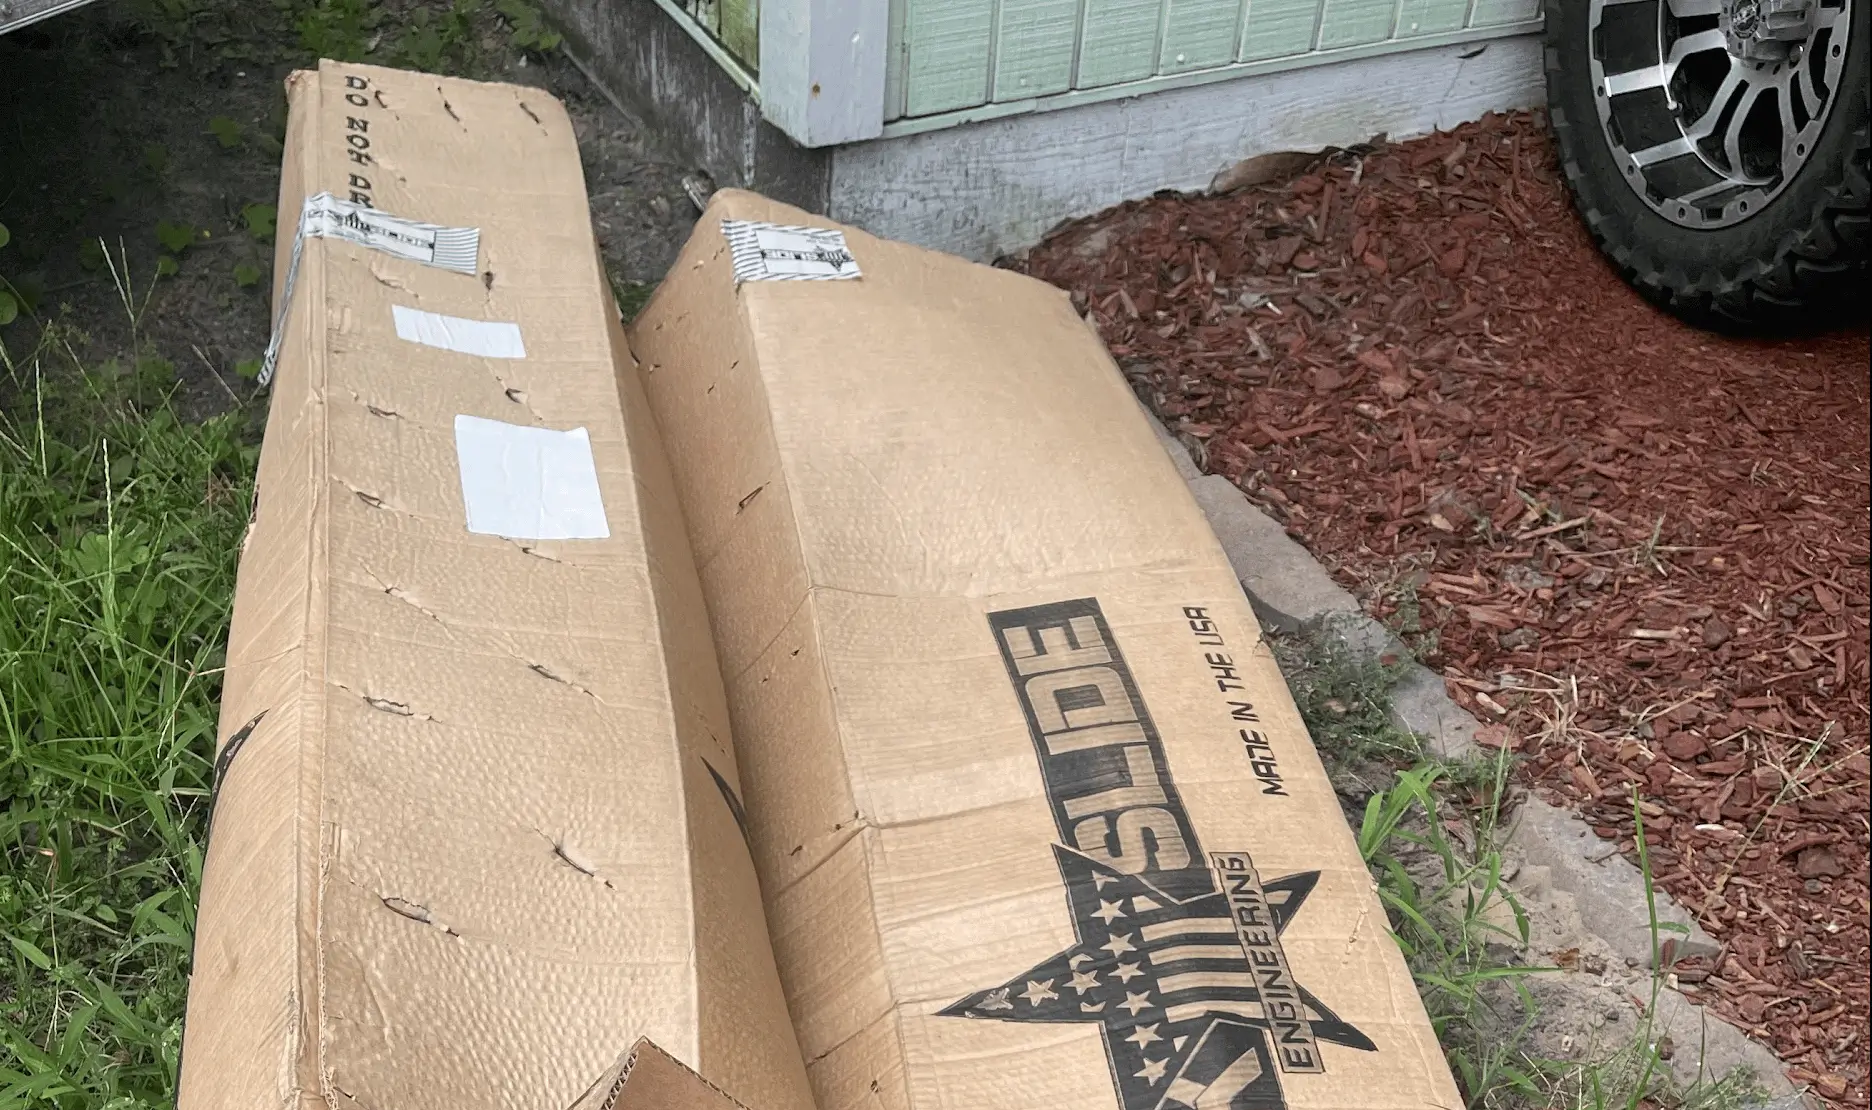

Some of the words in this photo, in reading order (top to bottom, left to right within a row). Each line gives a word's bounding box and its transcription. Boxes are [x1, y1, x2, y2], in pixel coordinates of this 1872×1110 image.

[345, 75, 370, 107] DO
[345, 117, 373, 168] NOT
[348, 173, 376, 209] DR
[1182, 606, 1224, 646] USA
[1204, 653, 1245, 692] THE
[1226, 701, 1260, 722] IN
[1002, 614, 1193, 878] SLIDE
[1240, 729, 1289, 797] MADE
[1214, 854, 1318, 1069] ENGINEERING
